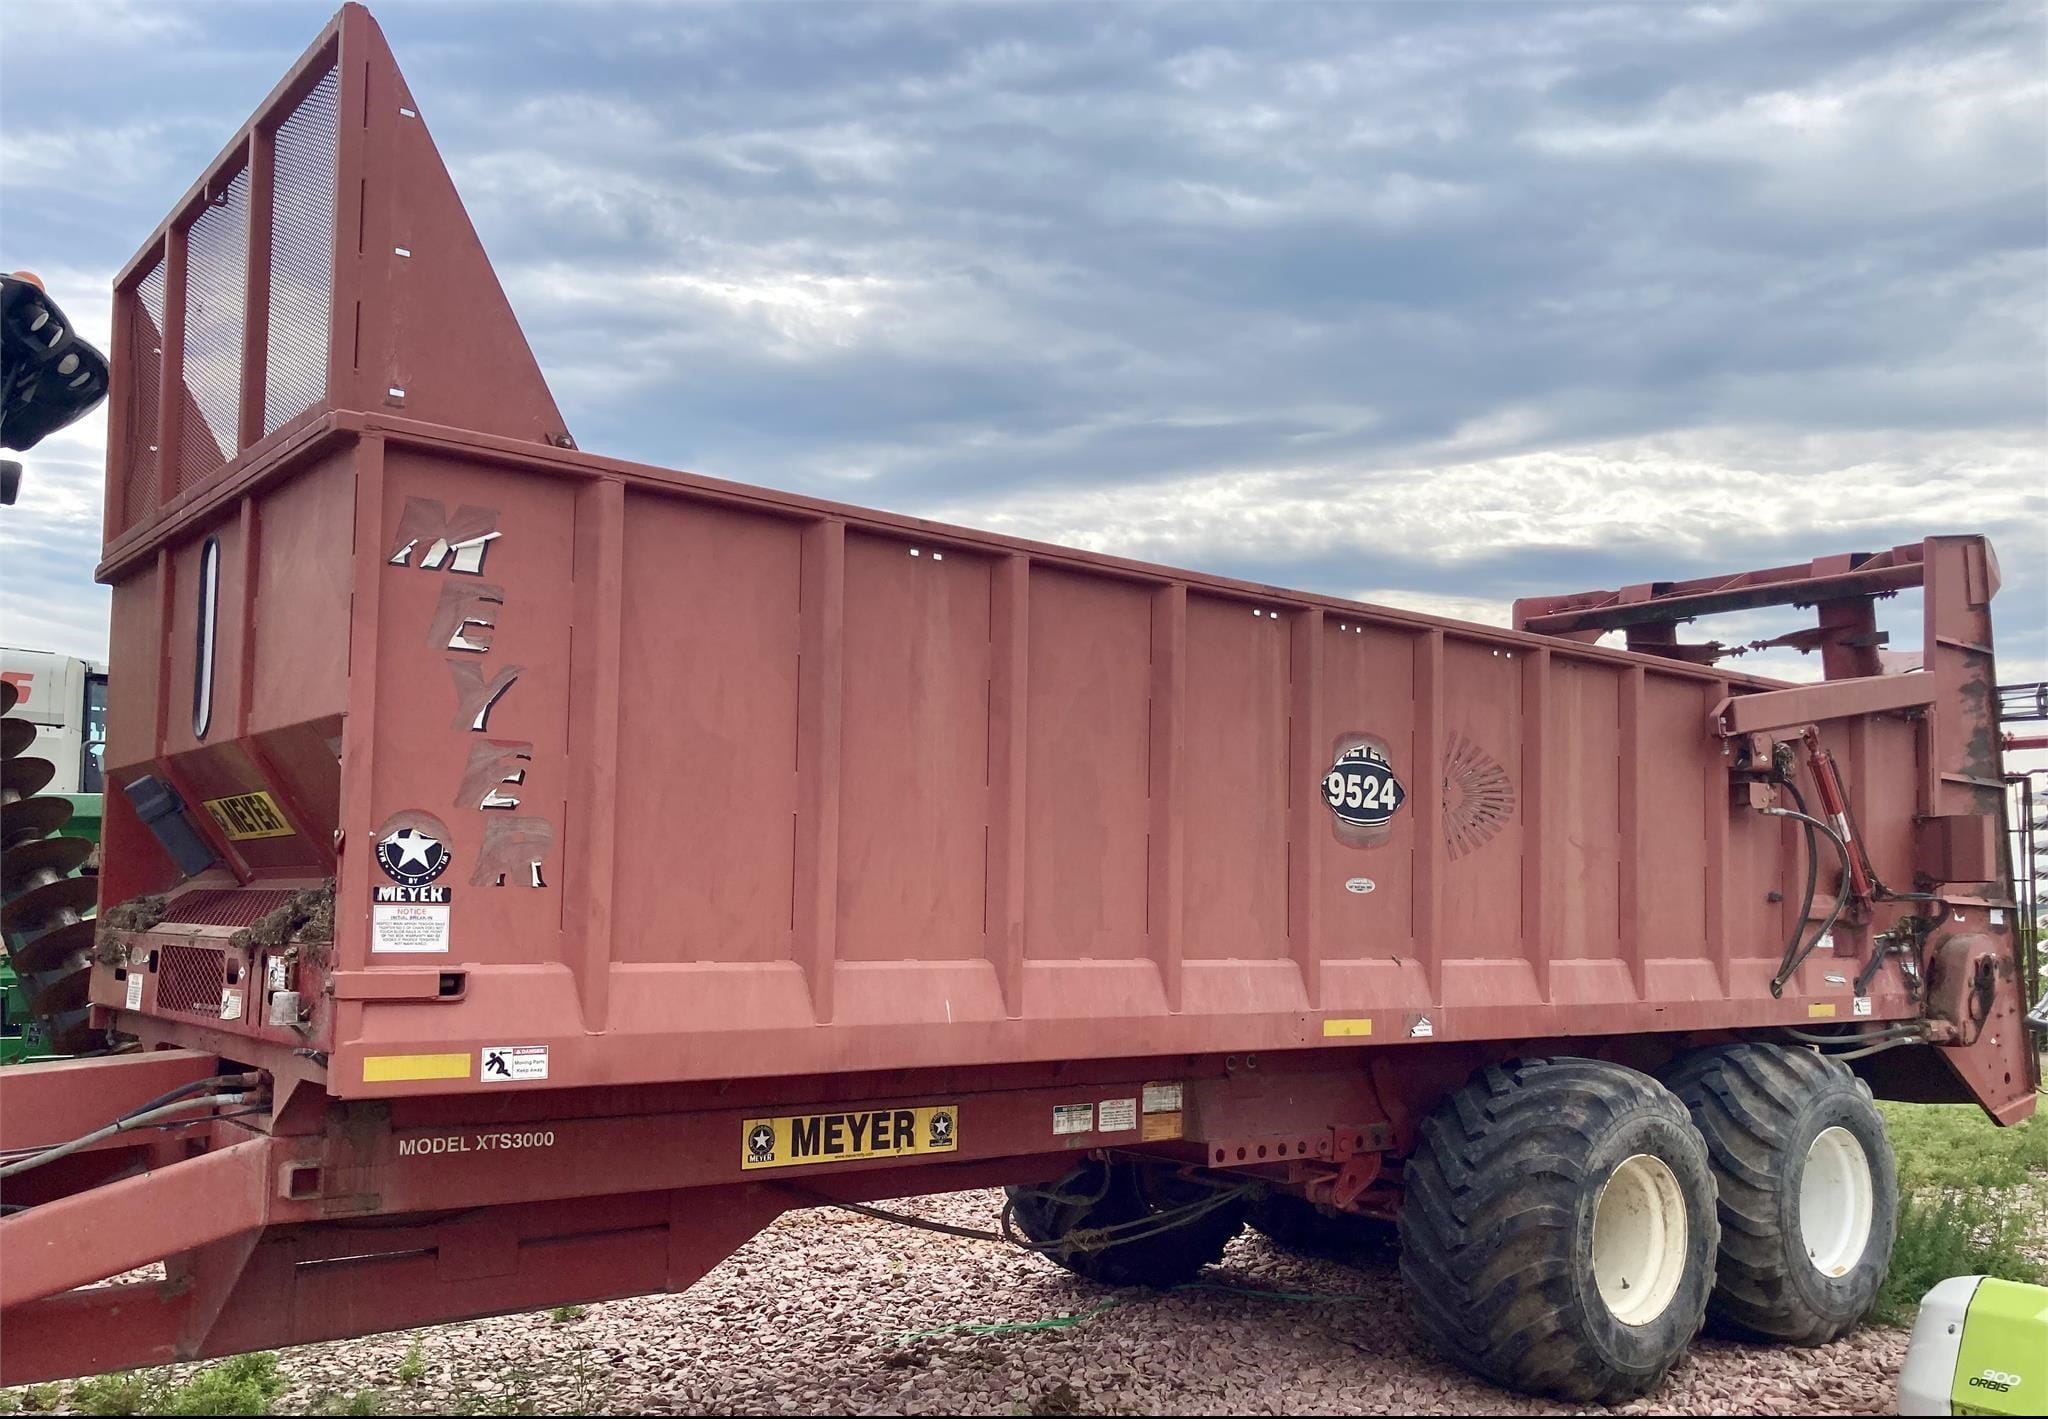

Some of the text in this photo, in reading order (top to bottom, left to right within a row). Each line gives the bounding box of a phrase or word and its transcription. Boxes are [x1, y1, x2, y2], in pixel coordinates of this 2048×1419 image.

[1328, 772, 1396, 810] 9524
[217, 795, 284, 833] MEYER
[378, 886, 443, 902] MEYER
[399, 1131, 555, 1156] MODEL XTS3000
[791, 1110, 915, 1157] MEYER
[749, 1154, 772, 1163] MEYER
[1969, 1377, 2010, 1393] ORBIS
